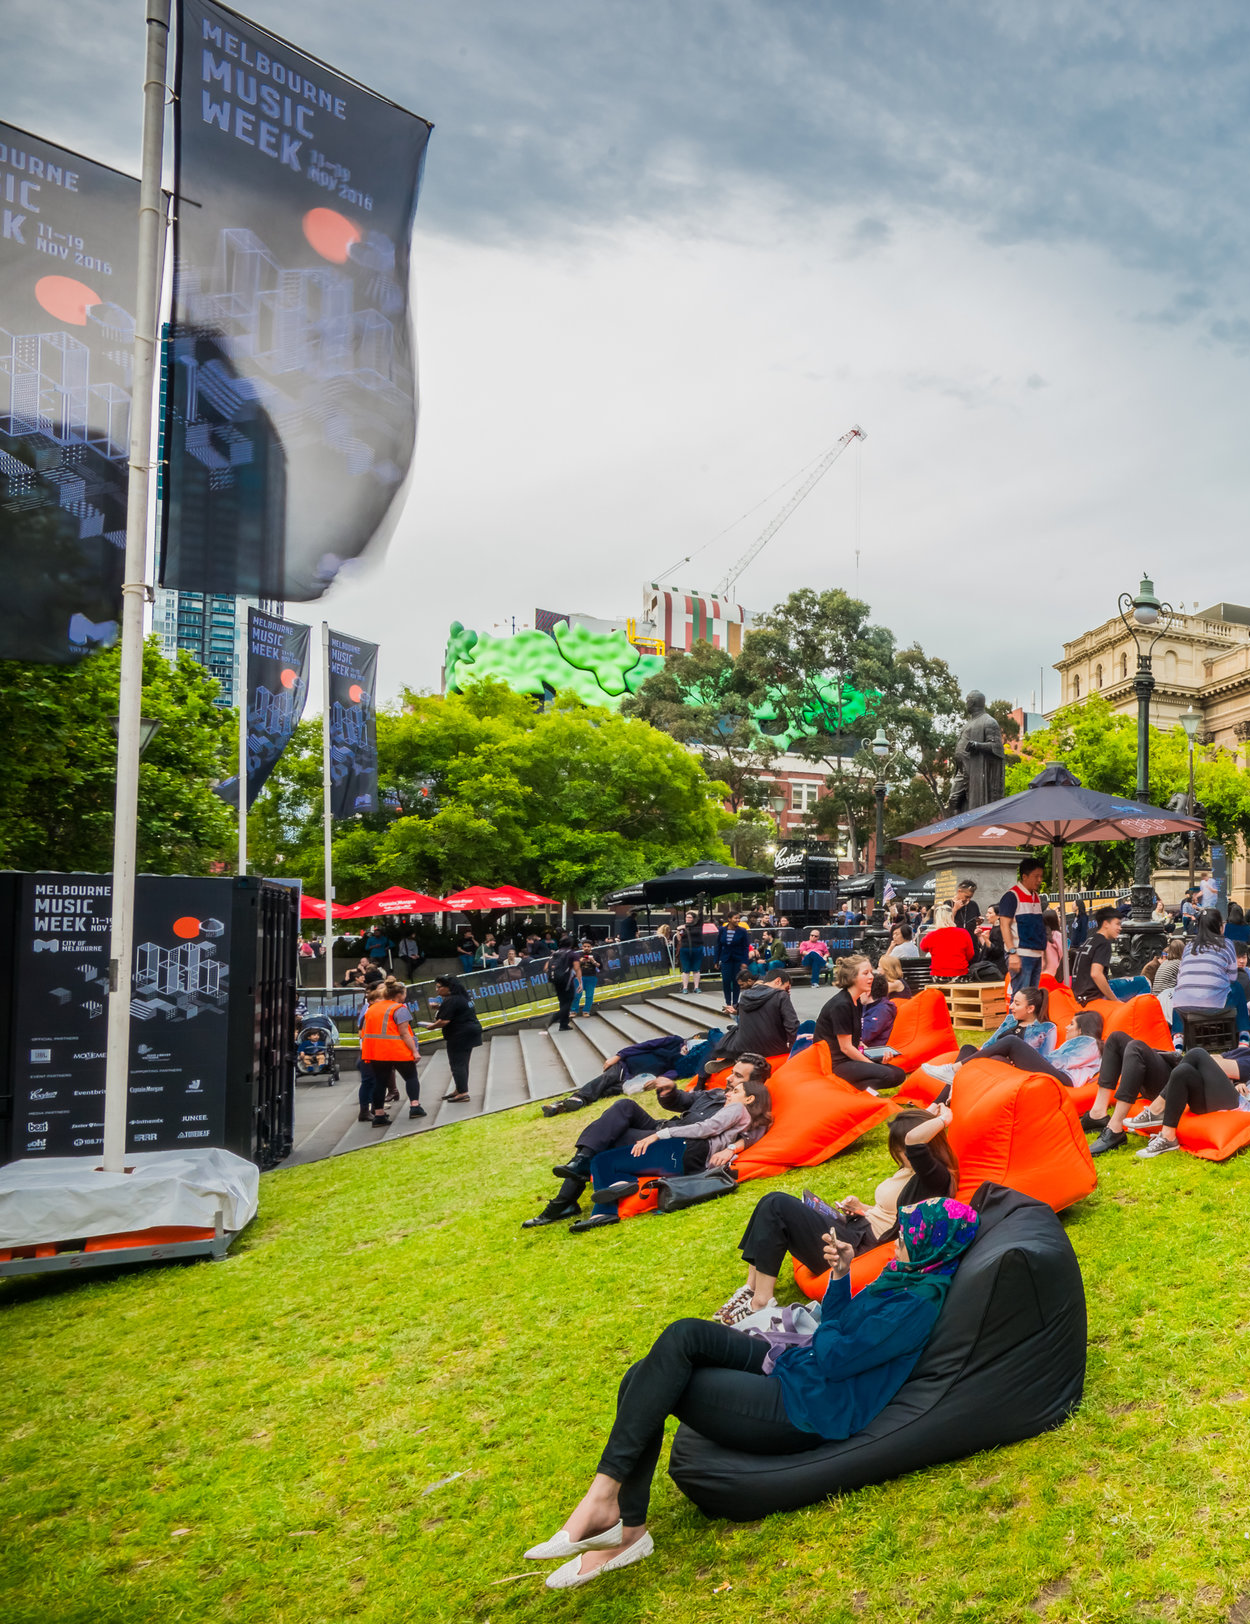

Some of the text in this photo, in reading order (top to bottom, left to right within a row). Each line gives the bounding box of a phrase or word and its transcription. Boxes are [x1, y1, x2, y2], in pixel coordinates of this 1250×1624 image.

[202, 18, 346, 120] MELBOURNE
[202, 49, 314, 140] MUSIC
[202, 88, 302, 172] WEEK
[0, 143, 79, 193] OURNE
[36, 236, 113, 275] NOV 2016
[252, 616, 294, 636] MELBOURNE
[252, 627, 284, 647] MUSIC
[252, 641, 280, 660] WEEK
[331, 648, 353, 666] MUSIC
[331, 662, 350, 678] WEEK
[35, 885, 112, 896] MELBOURNE
[34, 898, 94, 914] MUSIC
[34, 916, 87, 932] WEEK
[90, 924, 107, 932] NOV
[629, 951, 663, 966] #MMW
[467, 977, 529, 1001] ELBOURNE
